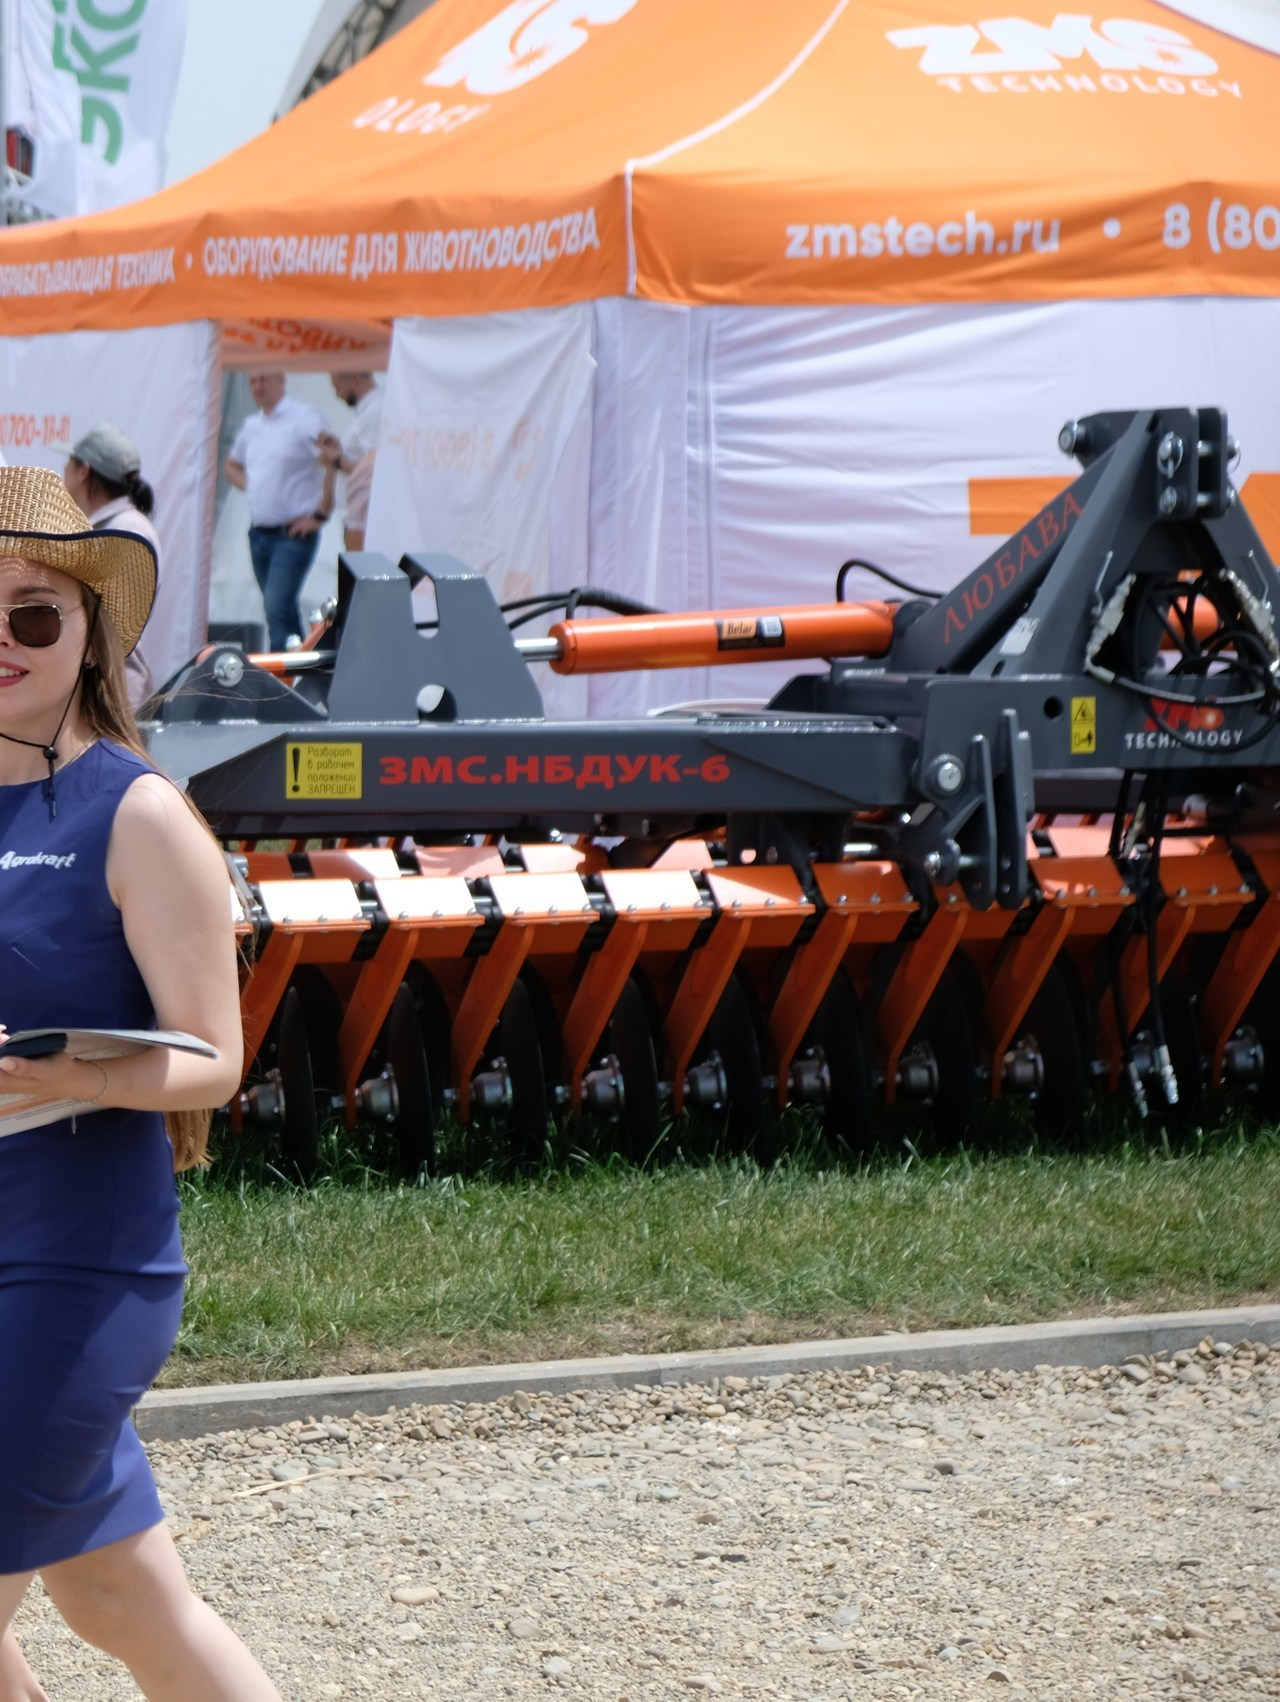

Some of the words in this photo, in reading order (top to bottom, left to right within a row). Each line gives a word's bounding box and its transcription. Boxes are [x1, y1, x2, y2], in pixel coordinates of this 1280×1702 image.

[935, 73, 1243, 98] TECHNOLOGY
[116, 246, 176, 291] ТЕХНИКА
[202, 233, 349, 281] ОБОРУДОВАНИЕ
[351, 231, 399, 281] ДЛЯ
[402, 206, 601, 272] ЖИВОТНОВОДСТВА
[784, 210, 1061, 259] zmstech.ru
[1162, 202, 1192, 250] 8
[944, 491, 1084, 645] ЛЮБАВА
[316, 758, 355, 771] рабочем
[378, 753, 732, 790] ЗМС.НБДУК-6
[308, 783, 356, 795] ЗАПРЕЩЕН
